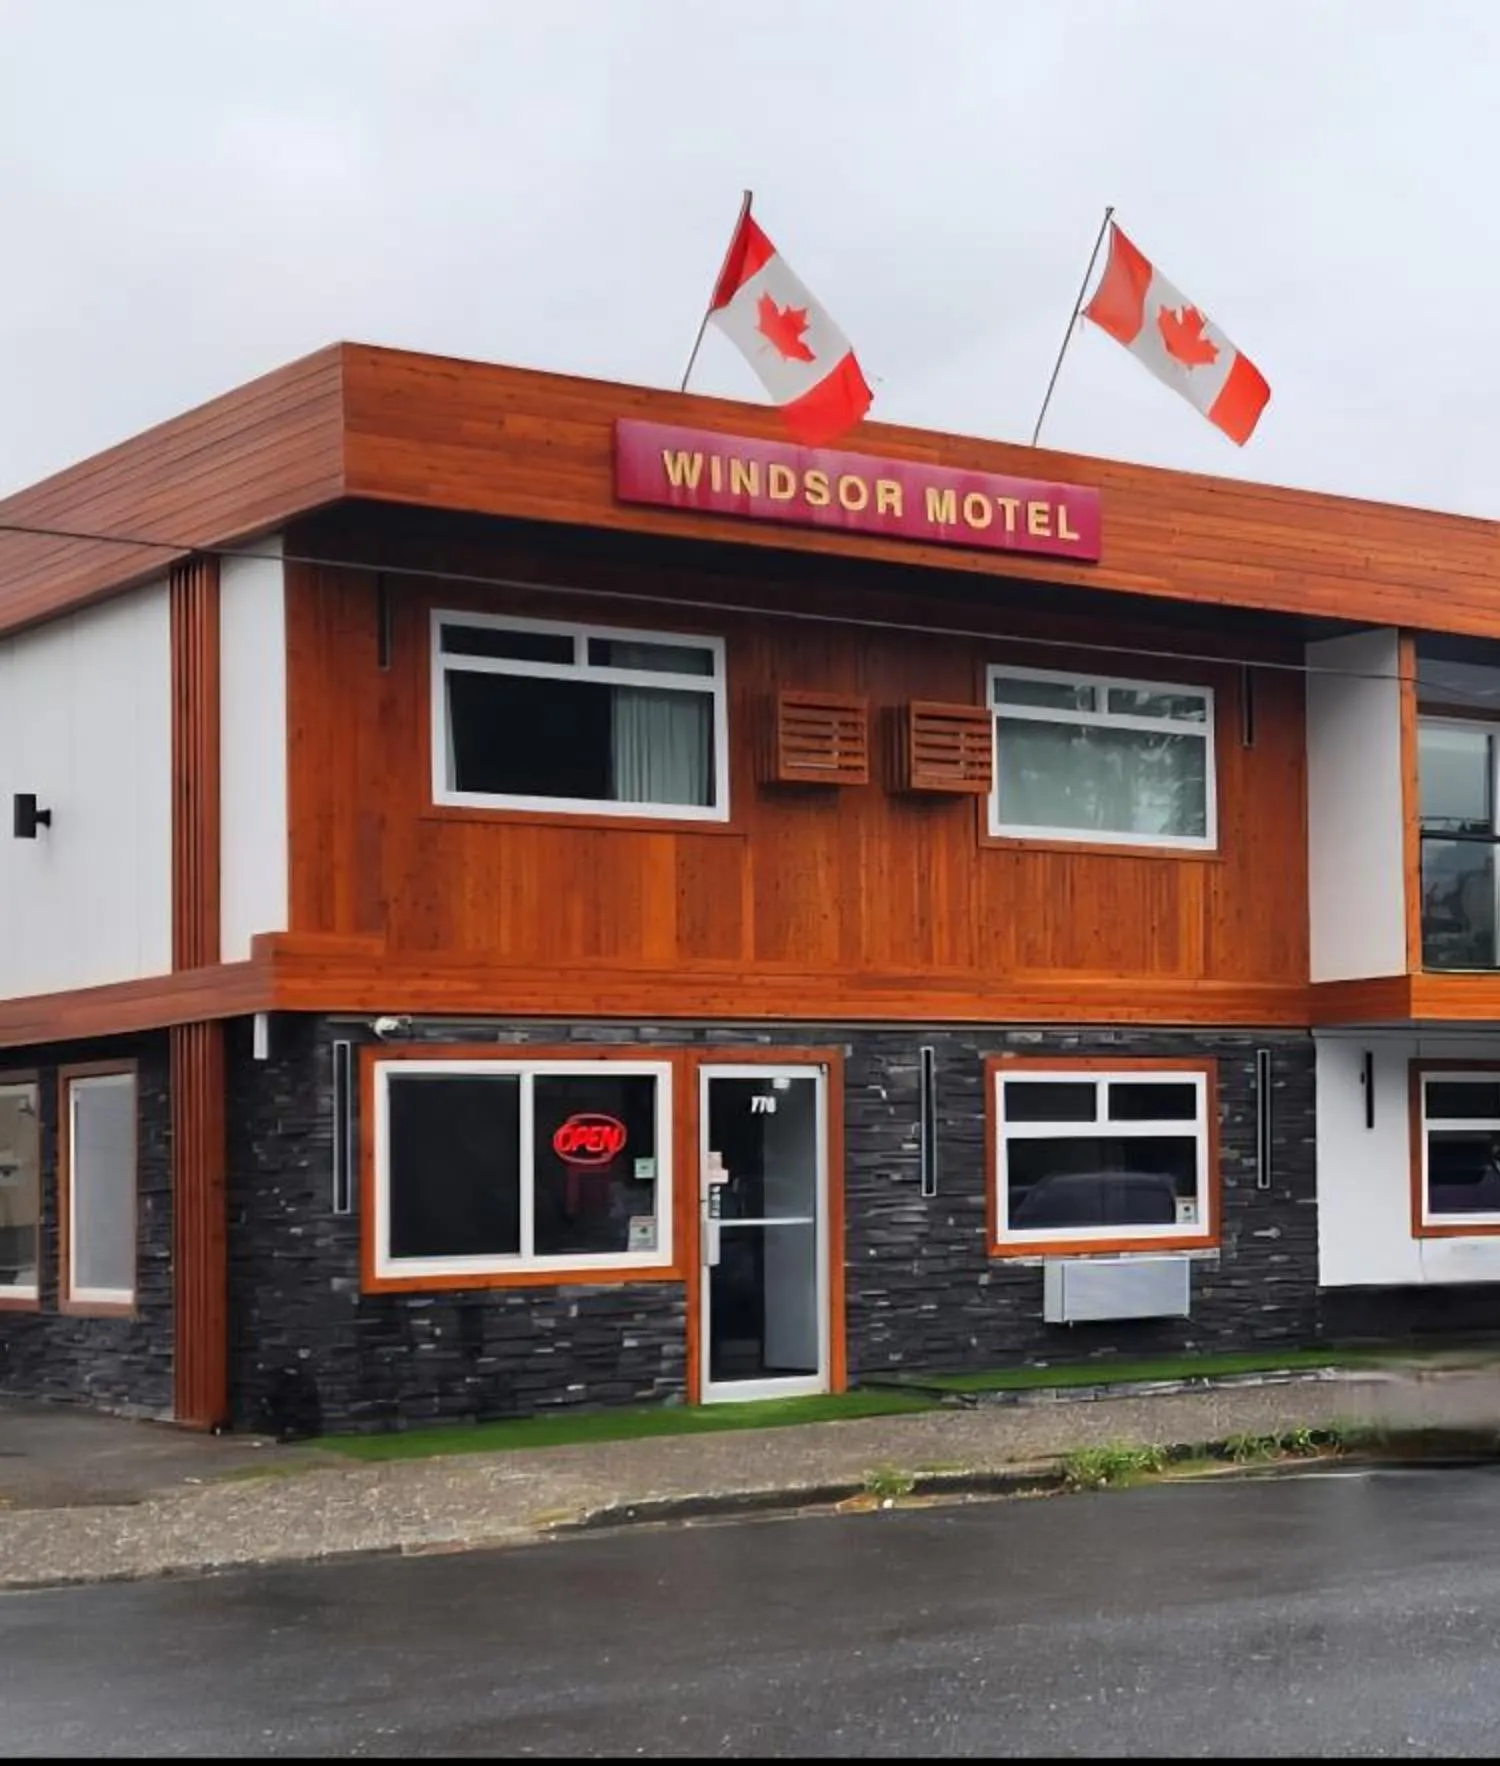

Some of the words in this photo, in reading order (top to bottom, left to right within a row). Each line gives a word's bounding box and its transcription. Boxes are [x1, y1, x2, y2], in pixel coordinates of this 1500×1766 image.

[662, 450, 904, 516] WINDSOR
[927, 489, 1080, 541] MOTEL
[557, 1123, 622, 1153] OPEN
